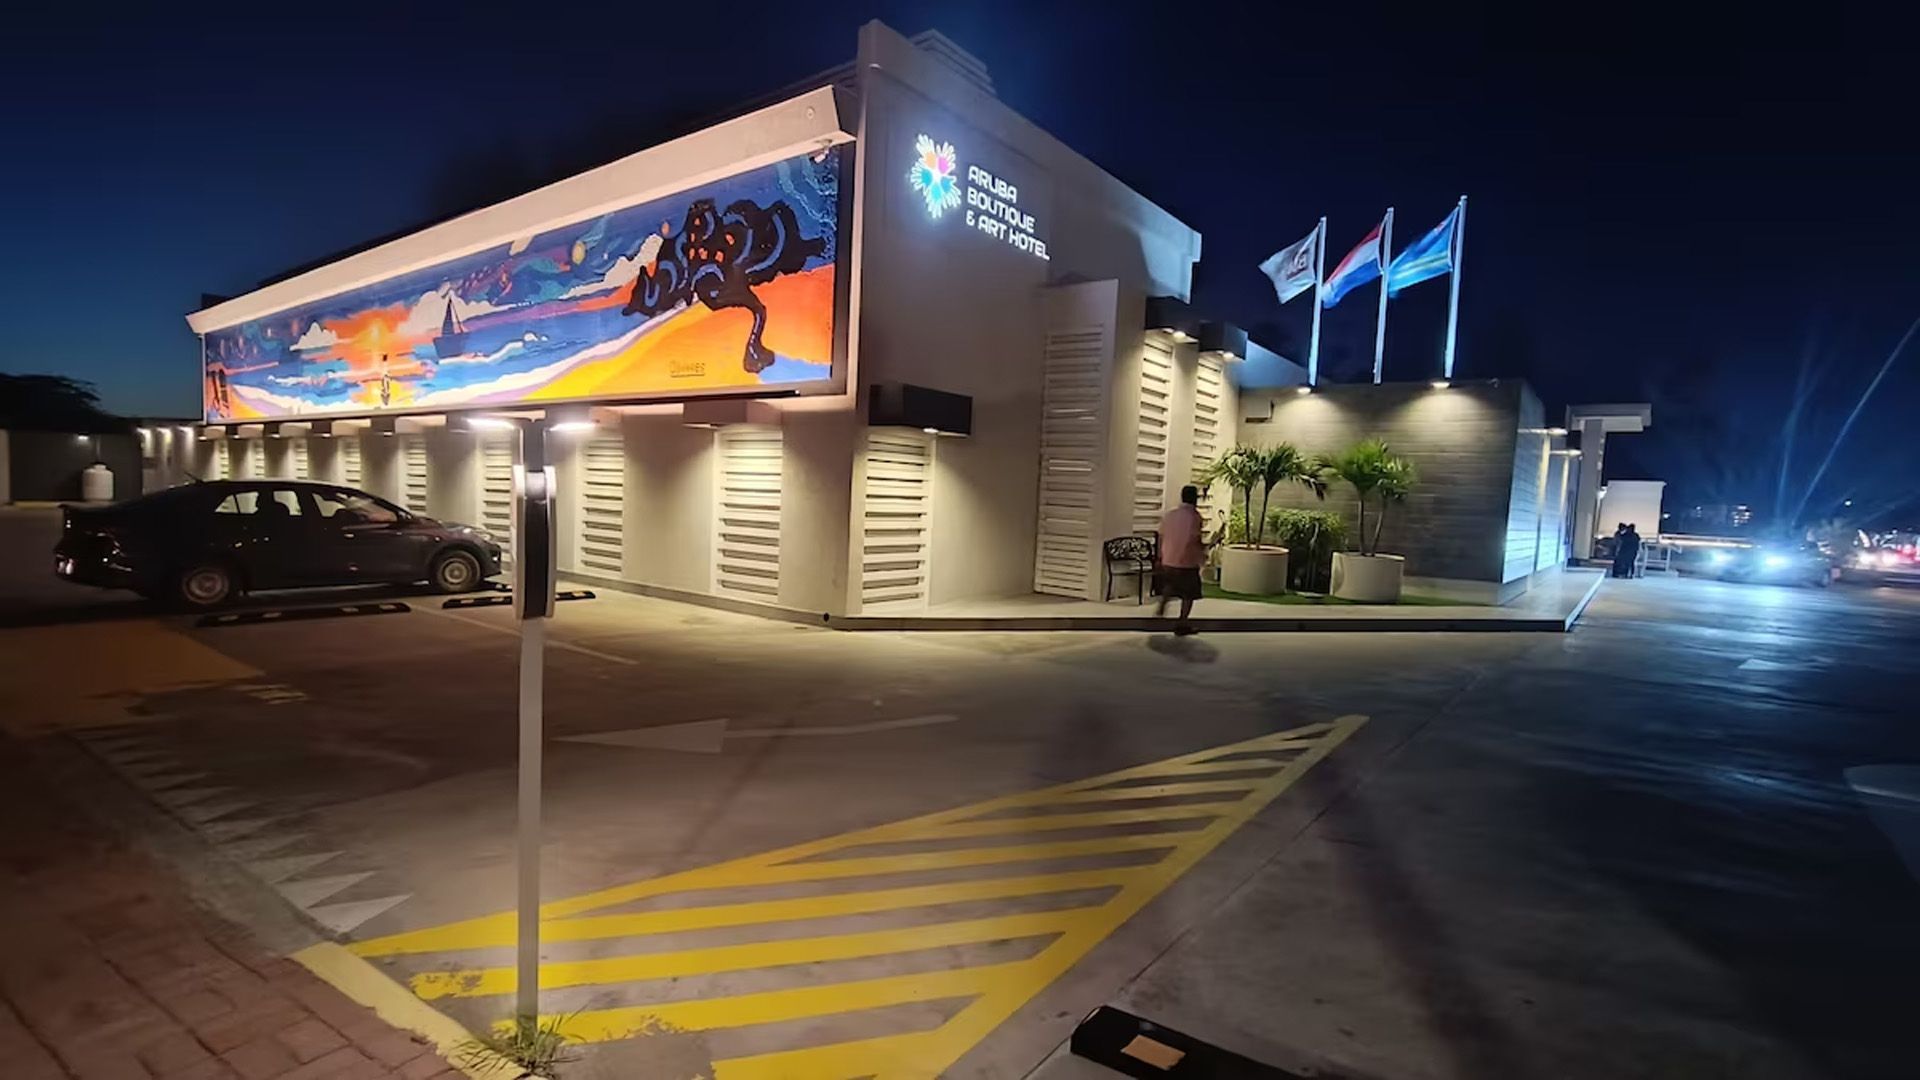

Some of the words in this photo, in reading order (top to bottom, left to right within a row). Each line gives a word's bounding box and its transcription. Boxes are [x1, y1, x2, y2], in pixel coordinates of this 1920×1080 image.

[968, 165, 1018, 204] ARUBA
[967, 186, 1035, 234] BOUTIQUE
[966, 209, 976, 226] &
[978, 215, 1008, 240] ART
[1008, 228, 1050, 261] HOTEL
